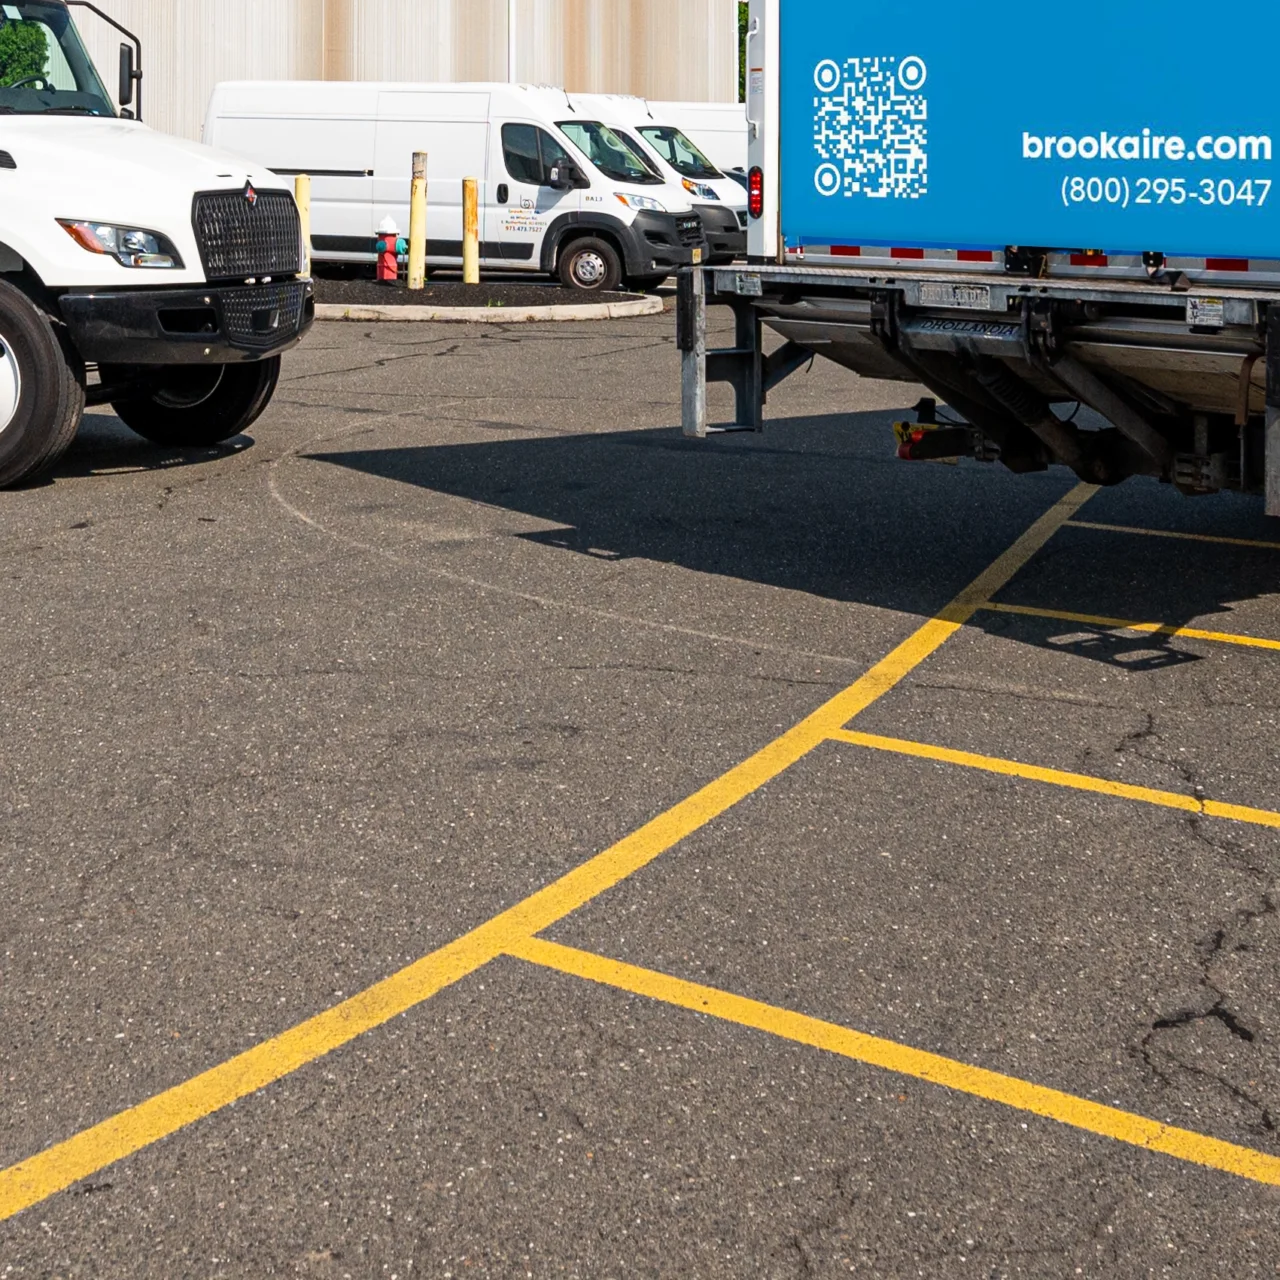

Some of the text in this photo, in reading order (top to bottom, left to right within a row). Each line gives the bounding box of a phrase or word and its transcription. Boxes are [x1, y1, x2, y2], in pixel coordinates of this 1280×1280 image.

[1023, 128, 1272, 161] brookaire.com
[1061, 176, 1272, 209] (800) 295-3047
[921, 320, 1017, 336] DHOLLANDIA
